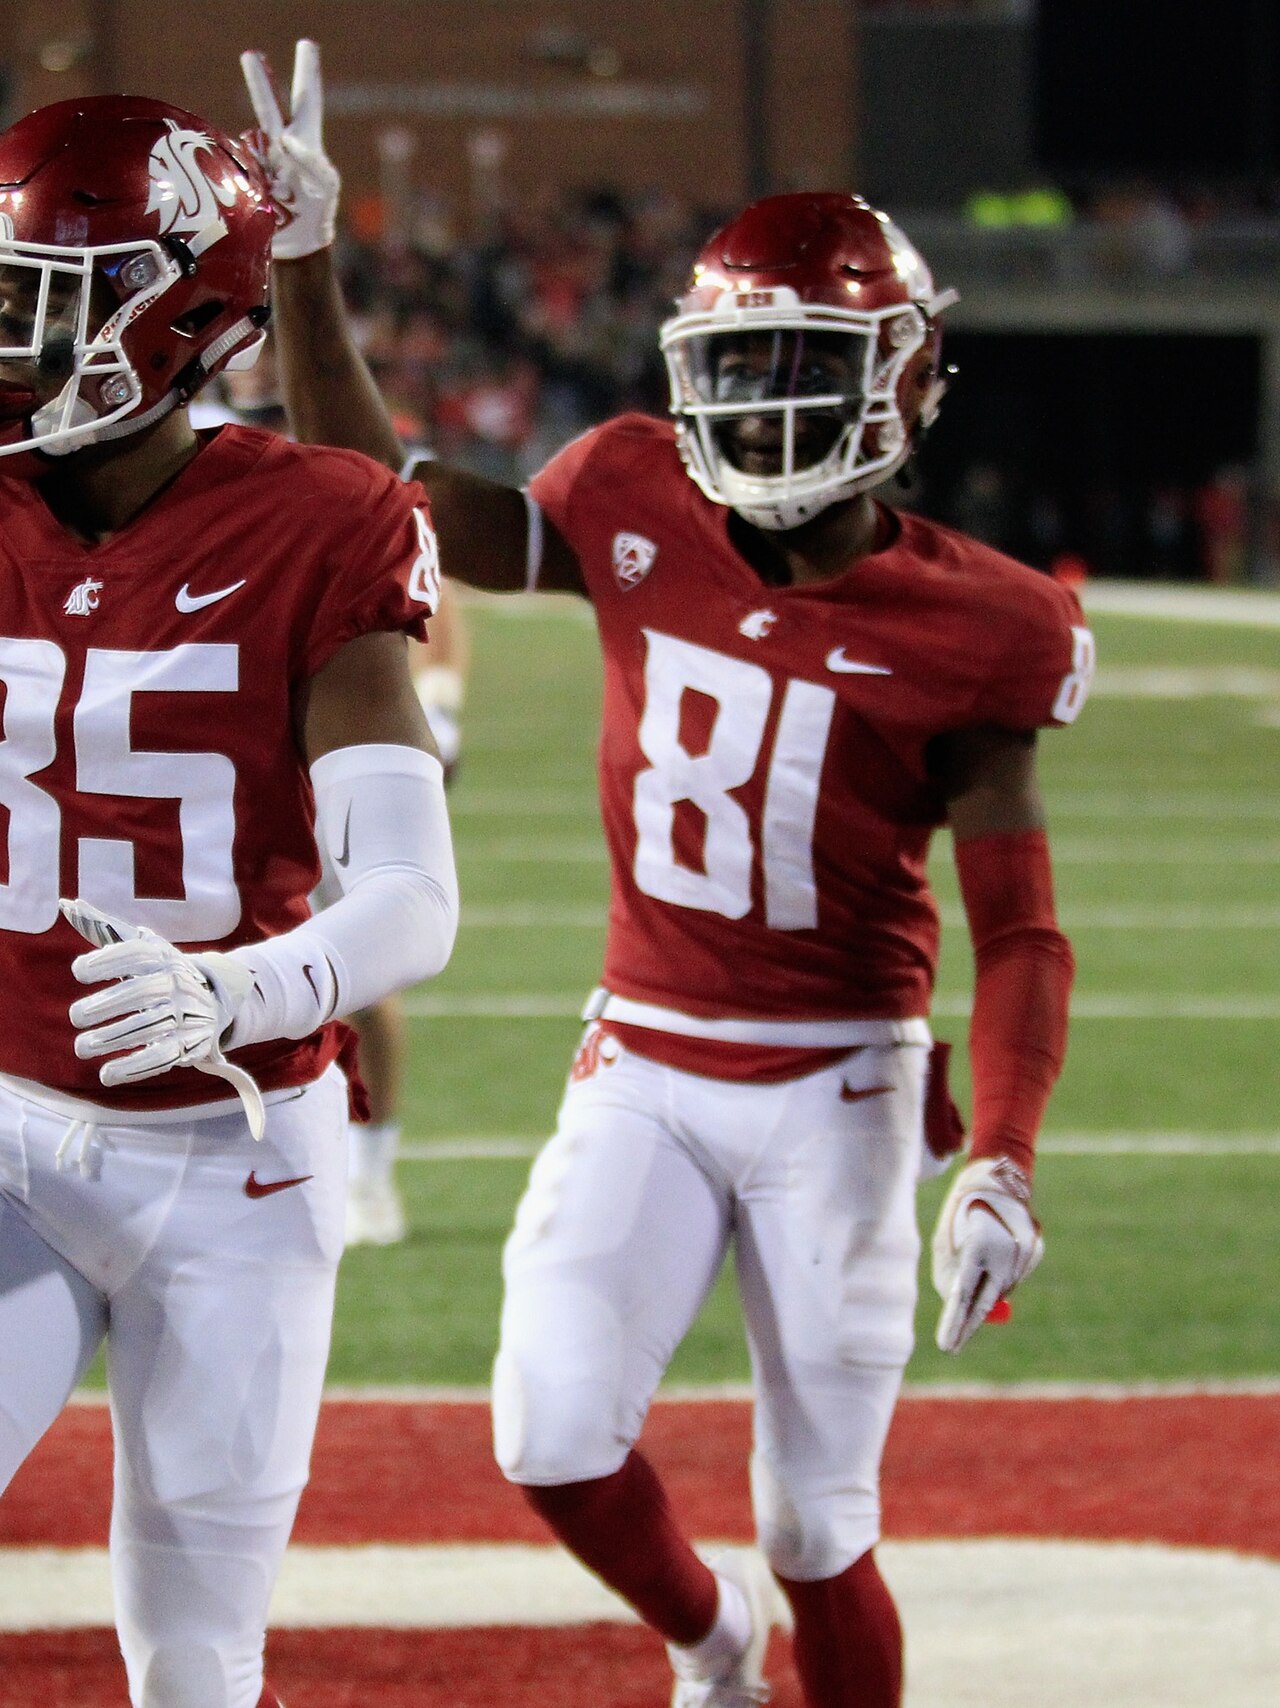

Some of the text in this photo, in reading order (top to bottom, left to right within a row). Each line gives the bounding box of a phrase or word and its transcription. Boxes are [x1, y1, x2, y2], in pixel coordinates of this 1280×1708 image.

[408, 507, 440, 615] 8
[1052, 626, 1096, 724] 8
[633, 628, 836, 931] 81
